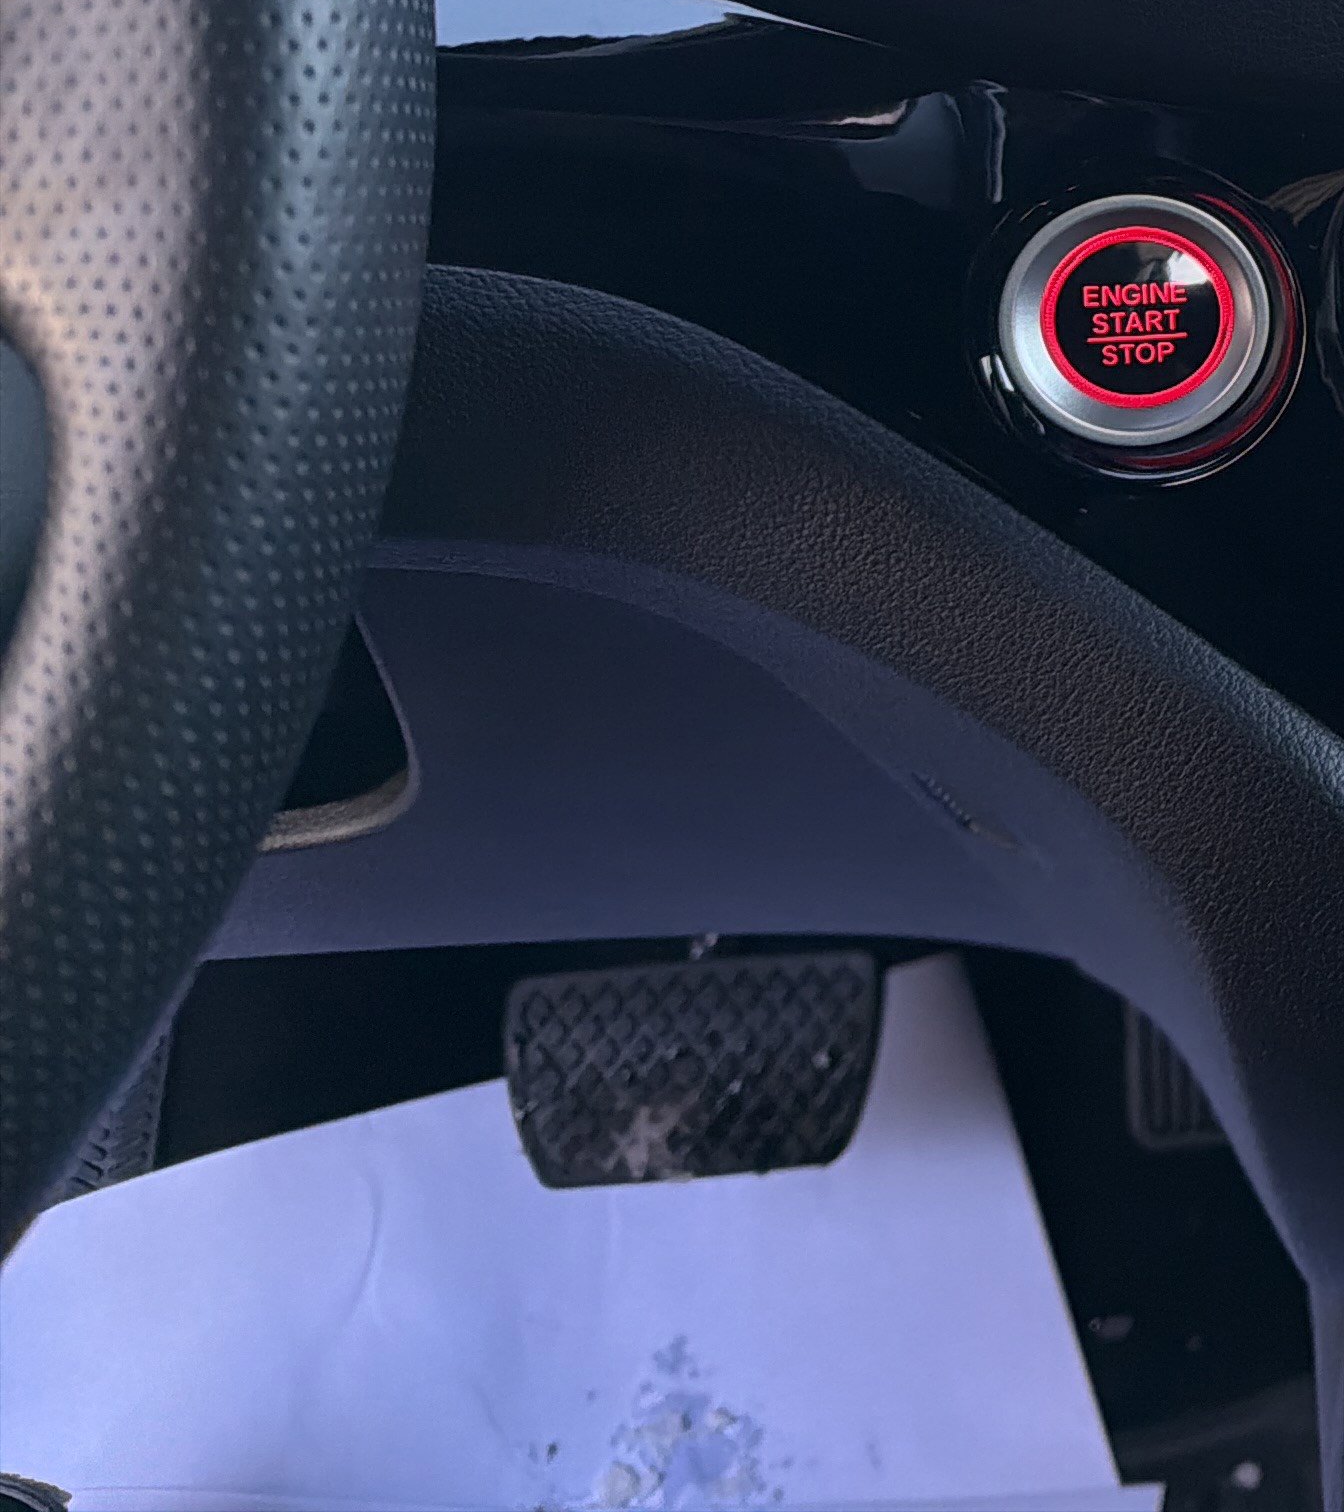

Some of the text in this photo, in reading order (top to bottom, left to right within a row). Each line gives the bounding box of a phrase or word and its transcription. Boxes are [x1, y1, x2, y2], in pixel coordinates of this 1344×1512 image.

[1083, 282, 1187, 307] ENGINE
[1092, 310, 1180, 334] START
[1102, 342, 1175, 365] STOP
